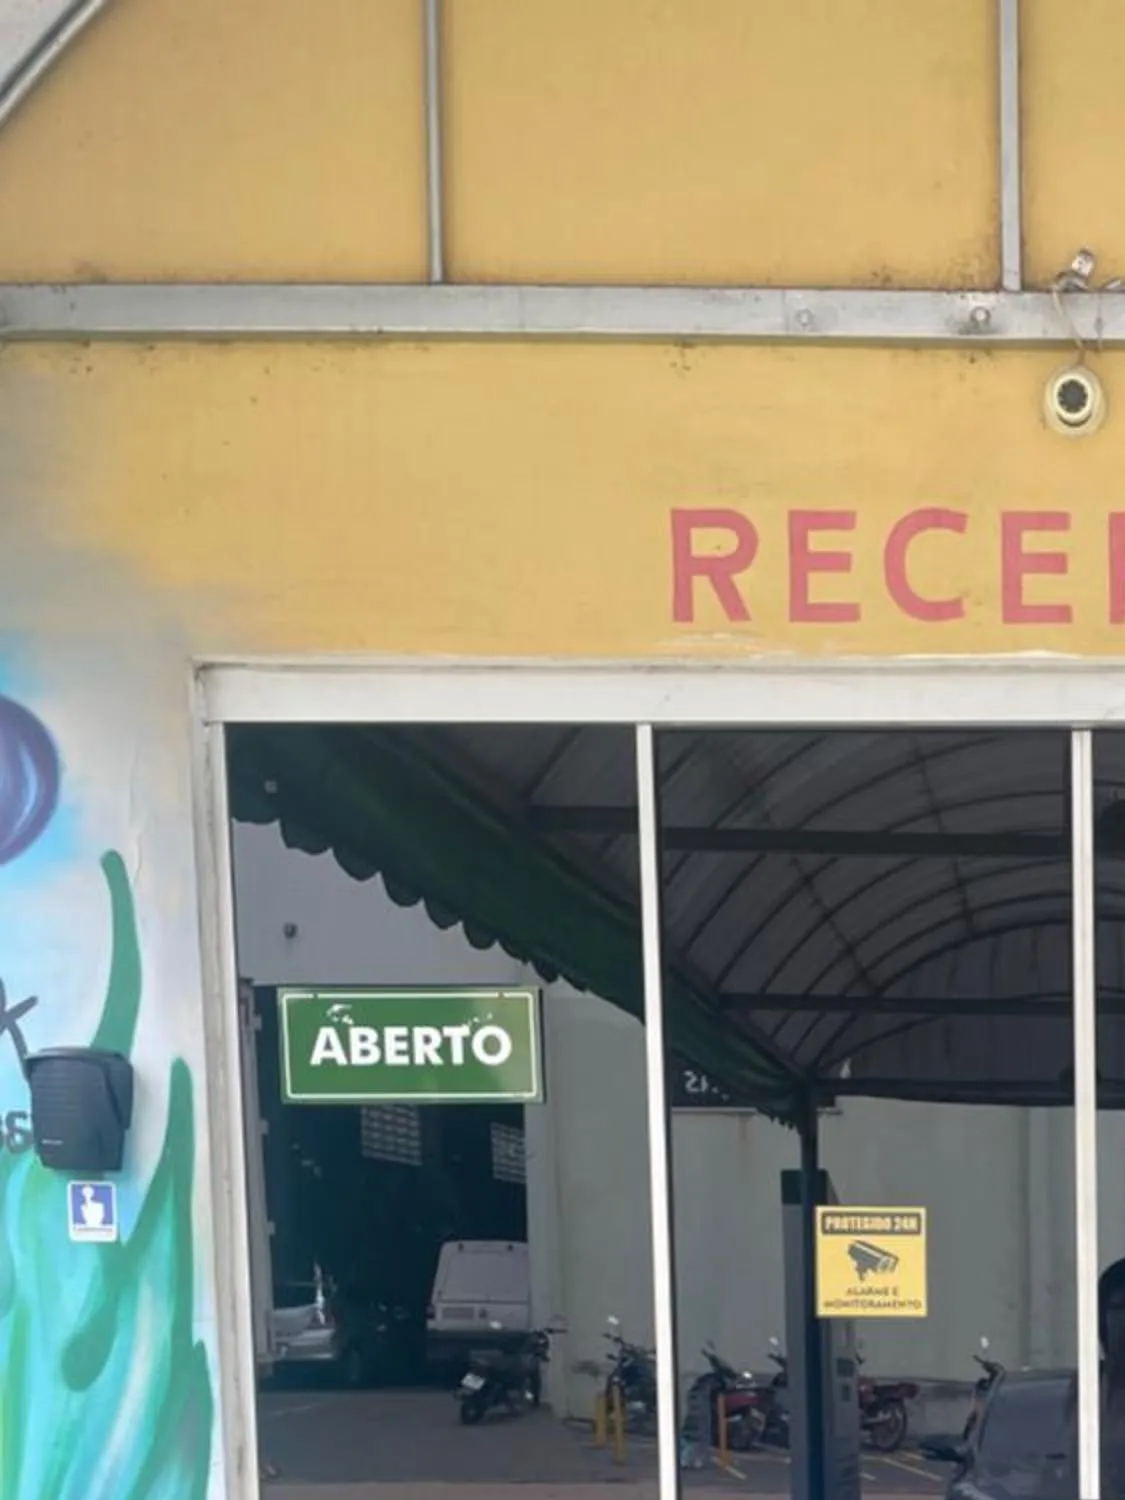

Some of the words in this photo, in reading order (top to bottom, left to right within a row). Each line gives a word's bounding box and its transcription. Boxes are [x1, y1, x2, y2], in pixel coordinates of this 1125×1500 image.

[310, 1023, 513, 1068] ABERTO
[825, 1215, 892, 1232] PROTEGIDO
[846, 1286, 890, 1297] ALARME
[892, 1286, 899, 1297] E
[823, 1298, 922, 1310] MONITORAMENTO
